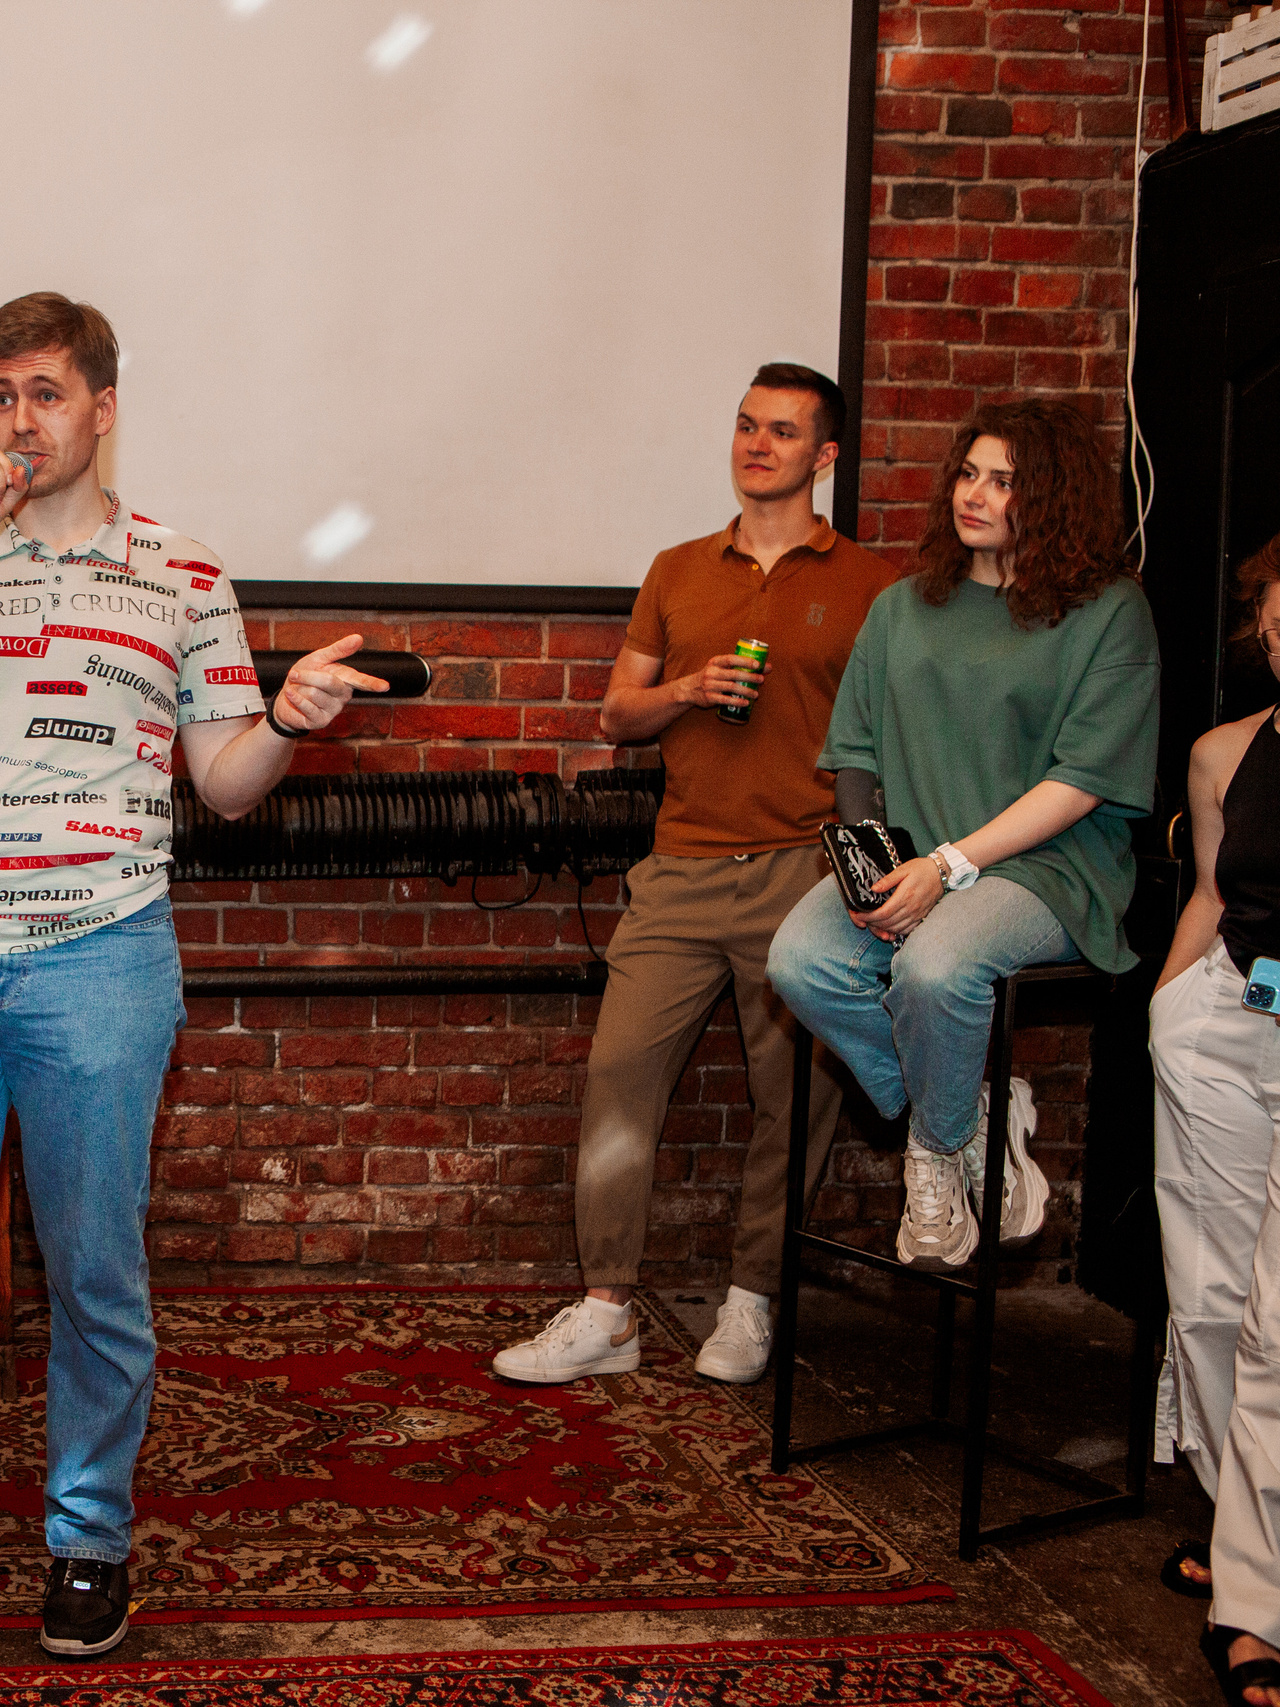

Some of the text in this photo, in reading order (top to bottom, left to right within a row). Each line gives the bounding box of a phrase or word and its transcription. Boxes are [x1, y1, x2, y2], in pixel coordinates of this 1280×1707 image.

[86, 557, 137, 576] trends
[93, 571, 177, 598] Inflation
[70, 593, 177, 627] CRUNCH
[28, 682, 84, 696] assets
[83, 654, 152, 704] looming
[30, 719, 109, 742] slump
[34, 761, 88, 780] endorses
[63, 790, 108, 804] rates
[26, 911, 117, 937] Inflation
